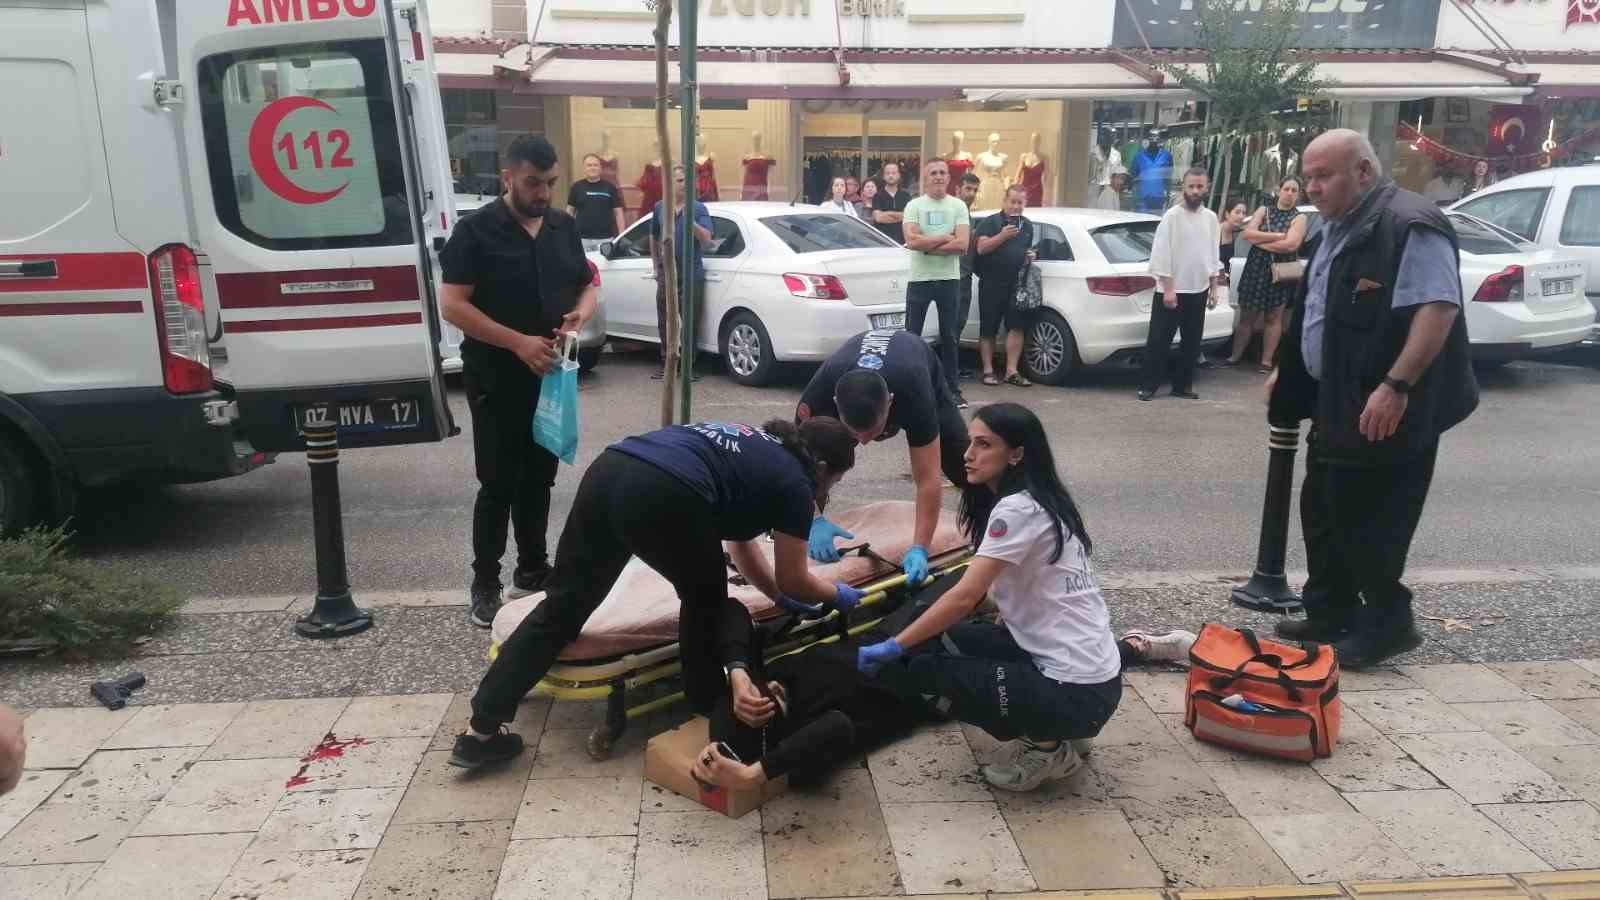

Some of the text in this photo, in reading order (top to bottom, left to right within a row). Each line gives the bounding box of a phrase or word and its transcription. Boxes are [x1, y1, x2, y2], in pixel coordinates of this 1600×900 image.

[278, 129, 354, 170] 112
[339, 405, 375, 426] MVA
[391, 400, 413, 423] 17
